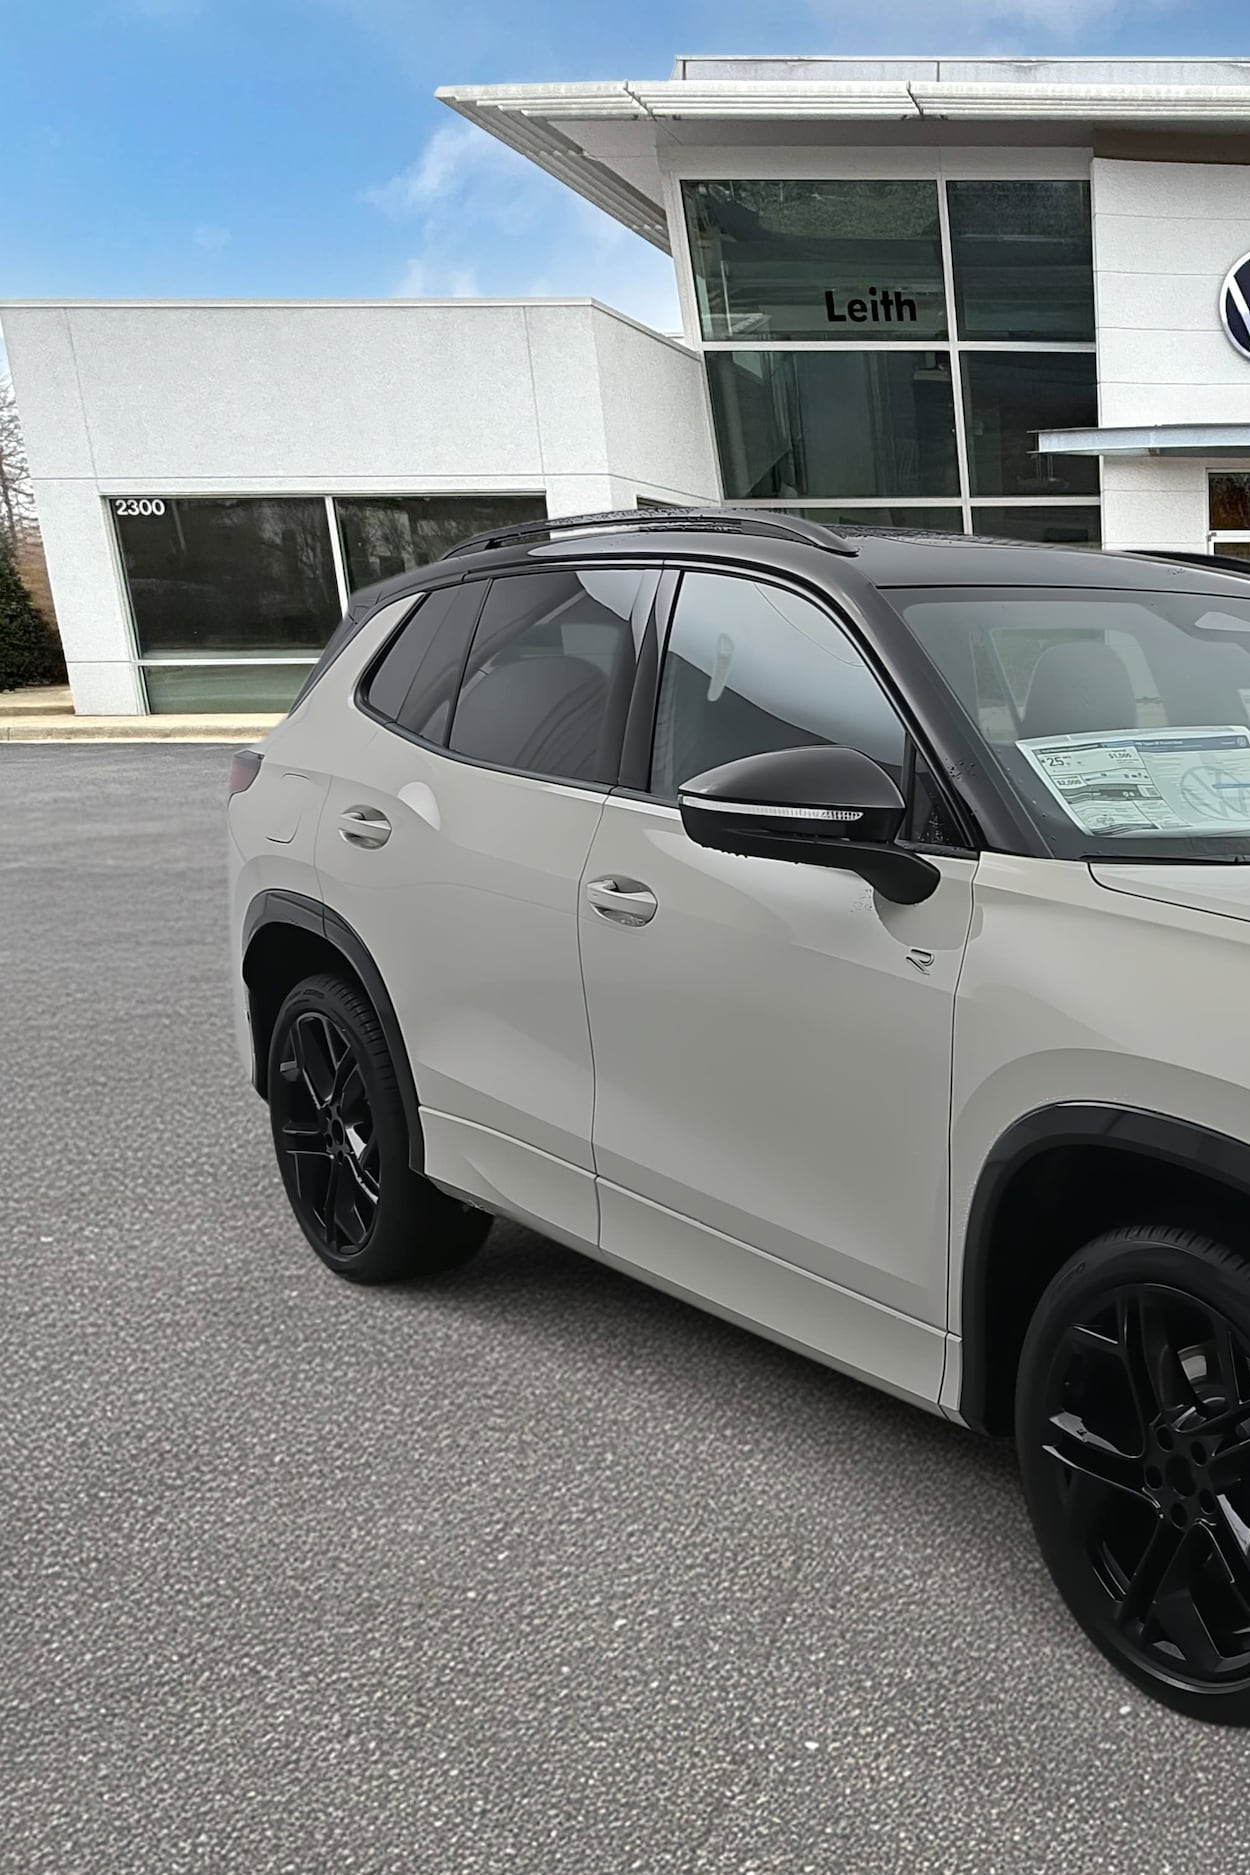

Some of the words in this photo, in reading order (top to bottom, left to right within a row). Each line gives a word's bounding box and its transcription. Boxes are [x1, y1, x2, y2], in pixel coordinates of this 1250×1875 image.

[825, 286, 917, 322] Leith
[115, 499, 165, 516] 2300
[1046, 757, 1065, 767] 25
